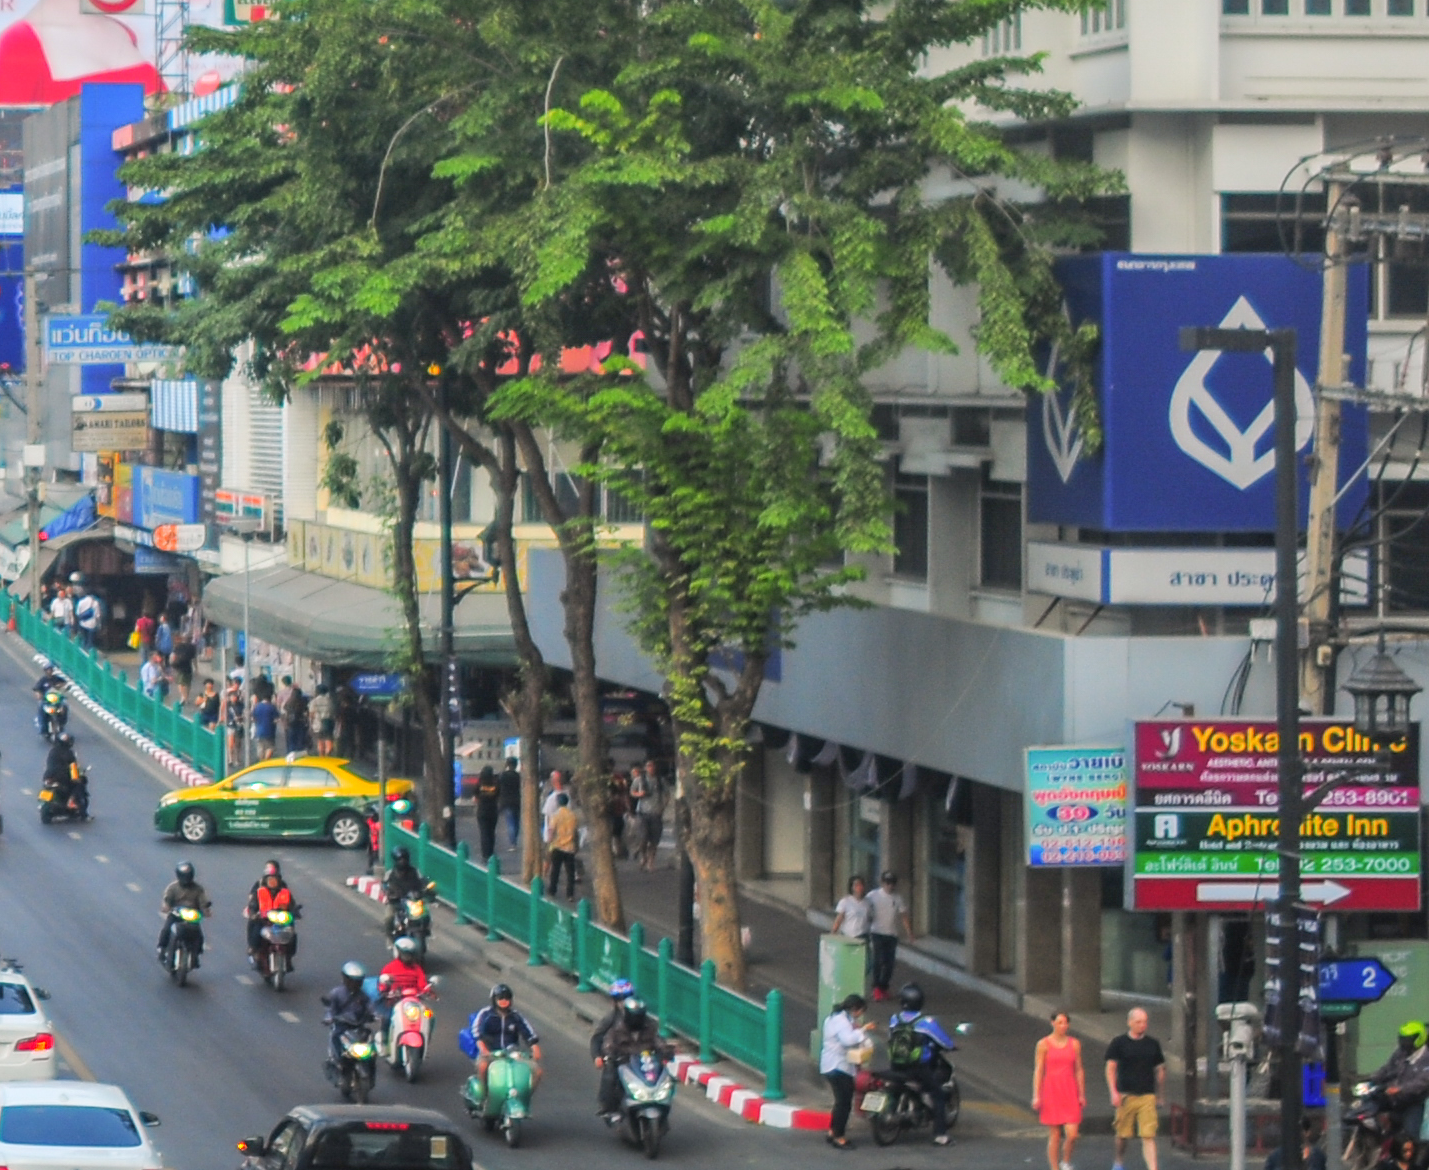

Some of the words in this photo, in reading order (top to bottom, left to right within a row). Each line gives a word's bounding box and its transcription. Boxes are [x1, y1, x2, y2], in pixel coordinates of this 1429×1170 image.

[1170, 571, 1218, 586] สาขา
[1192, 726, 1315, 753] Yoskan
[1141, 762, 1194, 772] YOSKARN
[1347, 814, 1389, 836] Inn
[1321, 857, 1410, 872] 253-7000
[1362, 966, 1376, 988] 2
